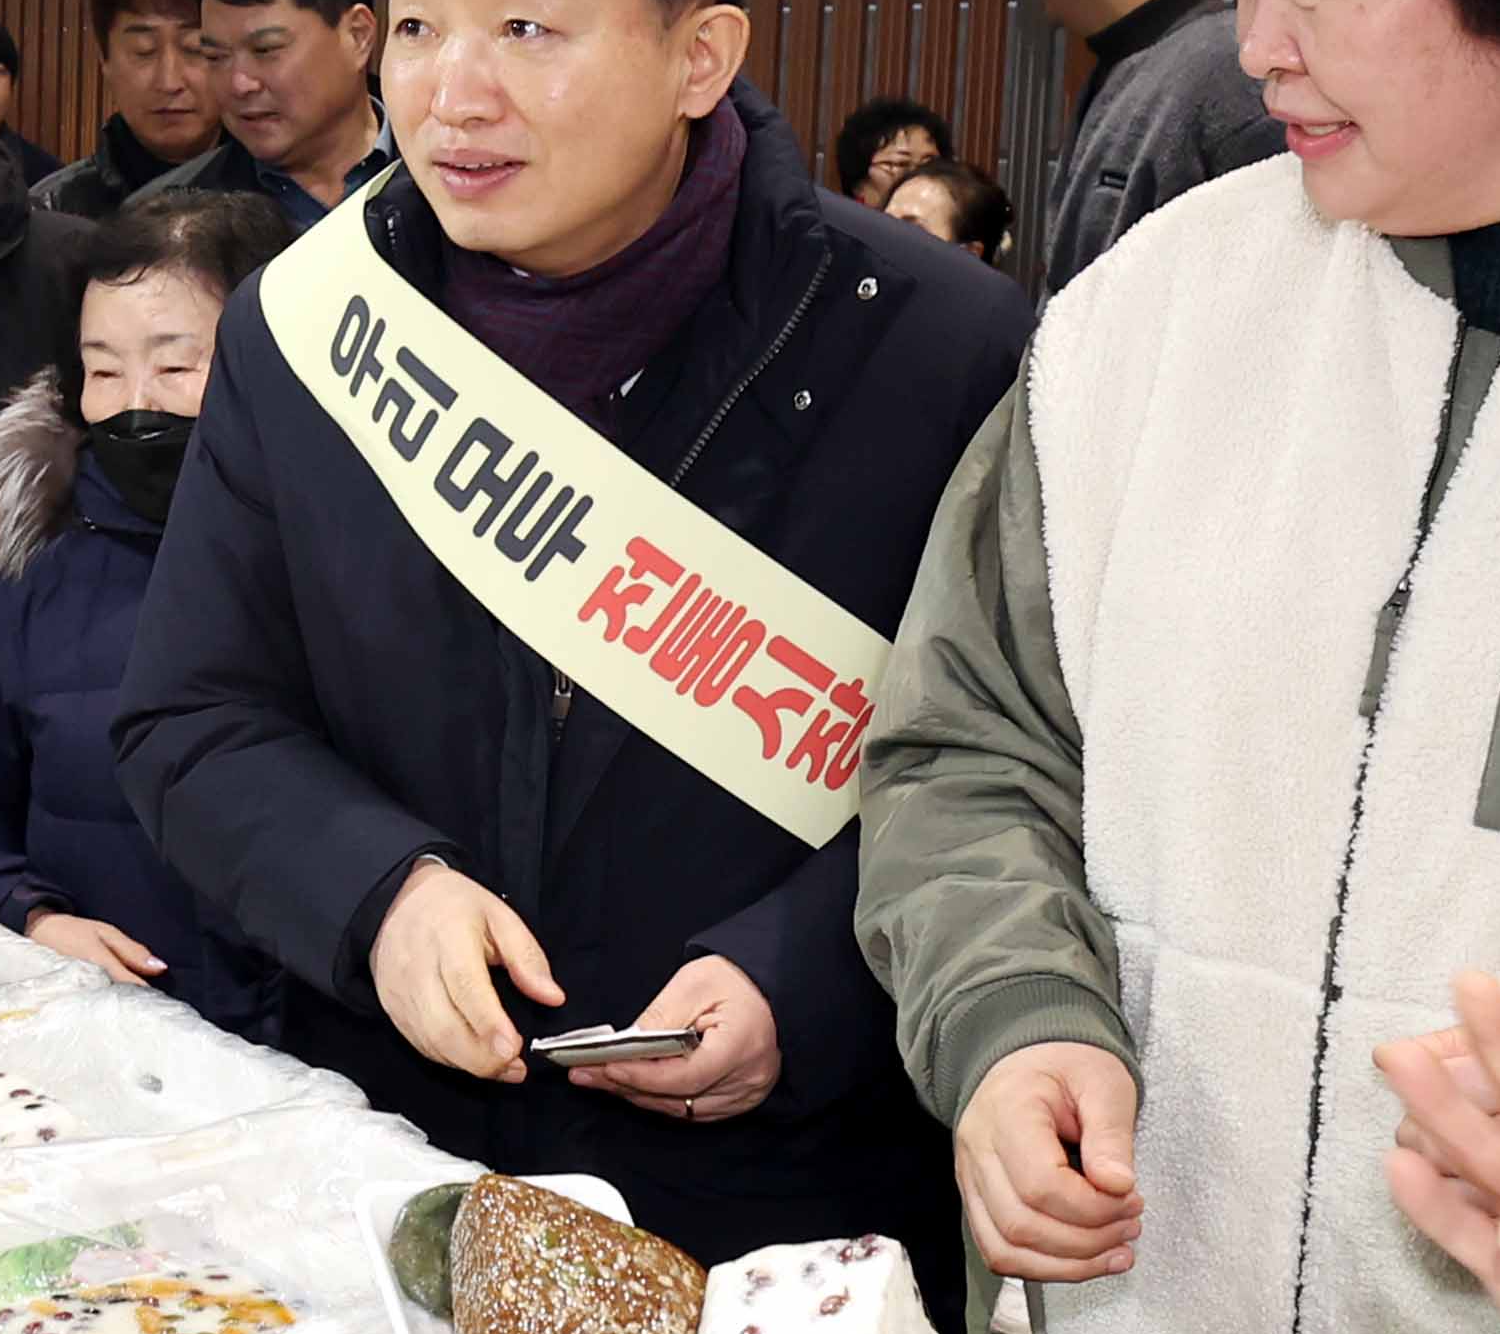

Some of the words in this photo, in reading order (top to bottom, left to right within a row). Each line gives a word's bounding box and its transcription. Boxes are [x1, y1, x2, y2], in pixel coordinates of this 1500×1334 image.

[330, 294, 459, 463] 우리
[433, 417, 595, 582] 모두
[577, 535, 878, 791] 전통시장
